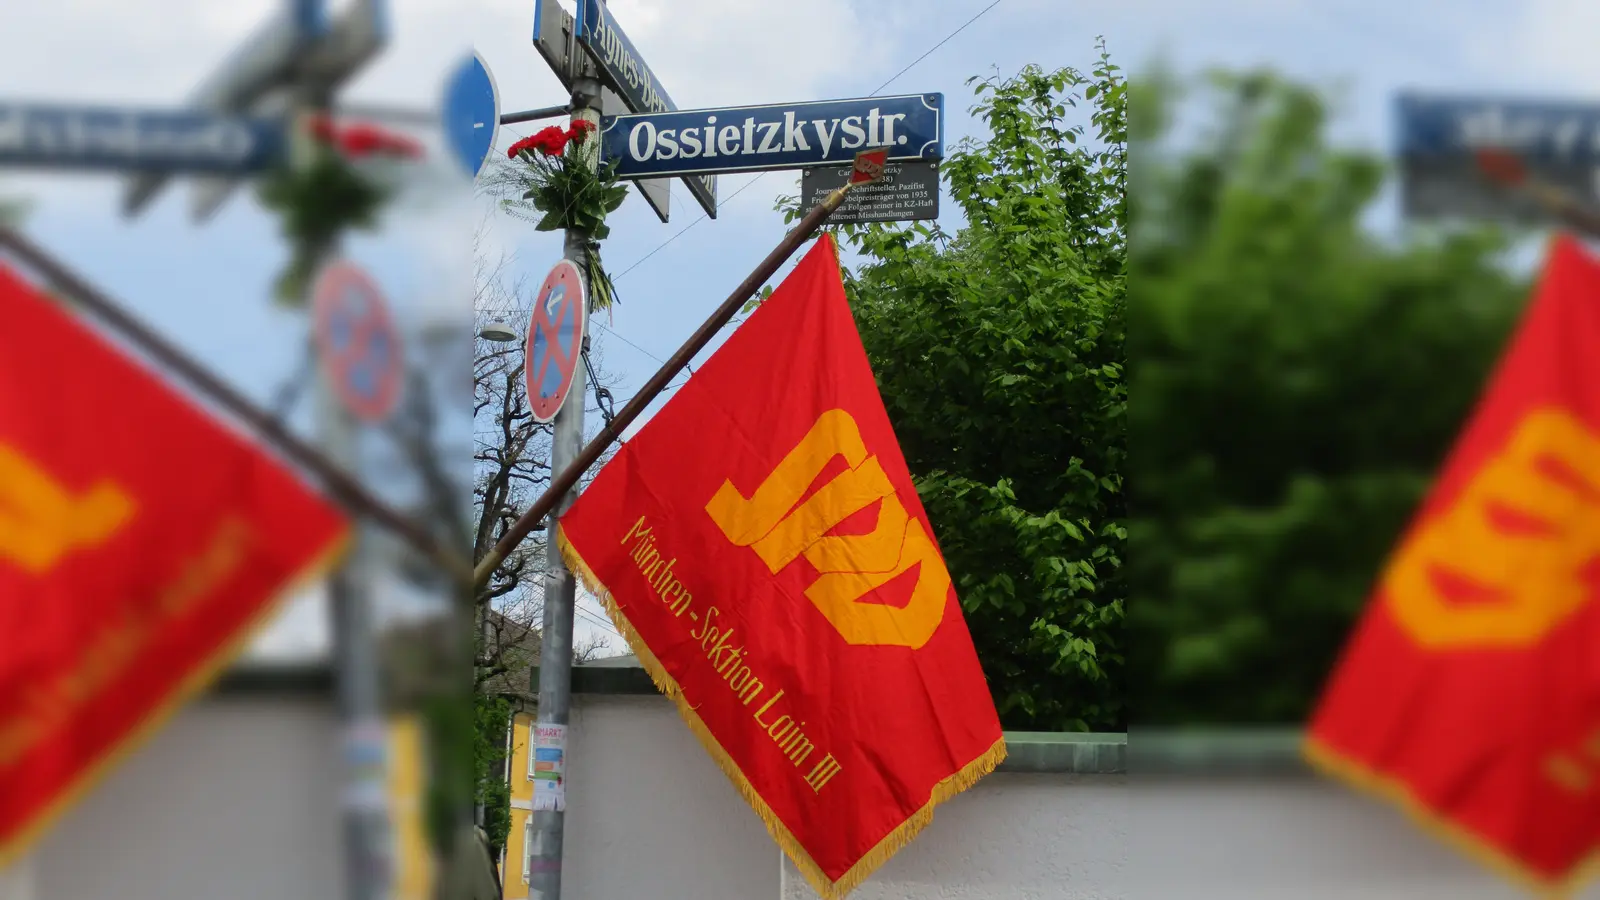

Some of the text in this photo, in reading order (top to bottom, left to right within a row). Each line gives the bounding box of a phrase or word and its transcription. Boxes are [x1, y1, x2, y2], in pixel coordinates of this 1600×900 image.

[594, 0, 669, 112] Agnes-Ber
[629, 108, 908, 162] Ossietzkystr.
[838, 166, 903, 177] Car etzky
[852, 184, 897, 193] Schriftsteller,
[898, 182, 925, 190] Pazifist
[829, 210, 914, 221] littenen Misshandlungen
[848, 203, 871, 212] Folgen
[904, 199, 933, 208] KZ-Haft
[706, 408, 950, 649] SPD
[753, 688, 815, 767] Laim
[803, 751, 843, 796] III
